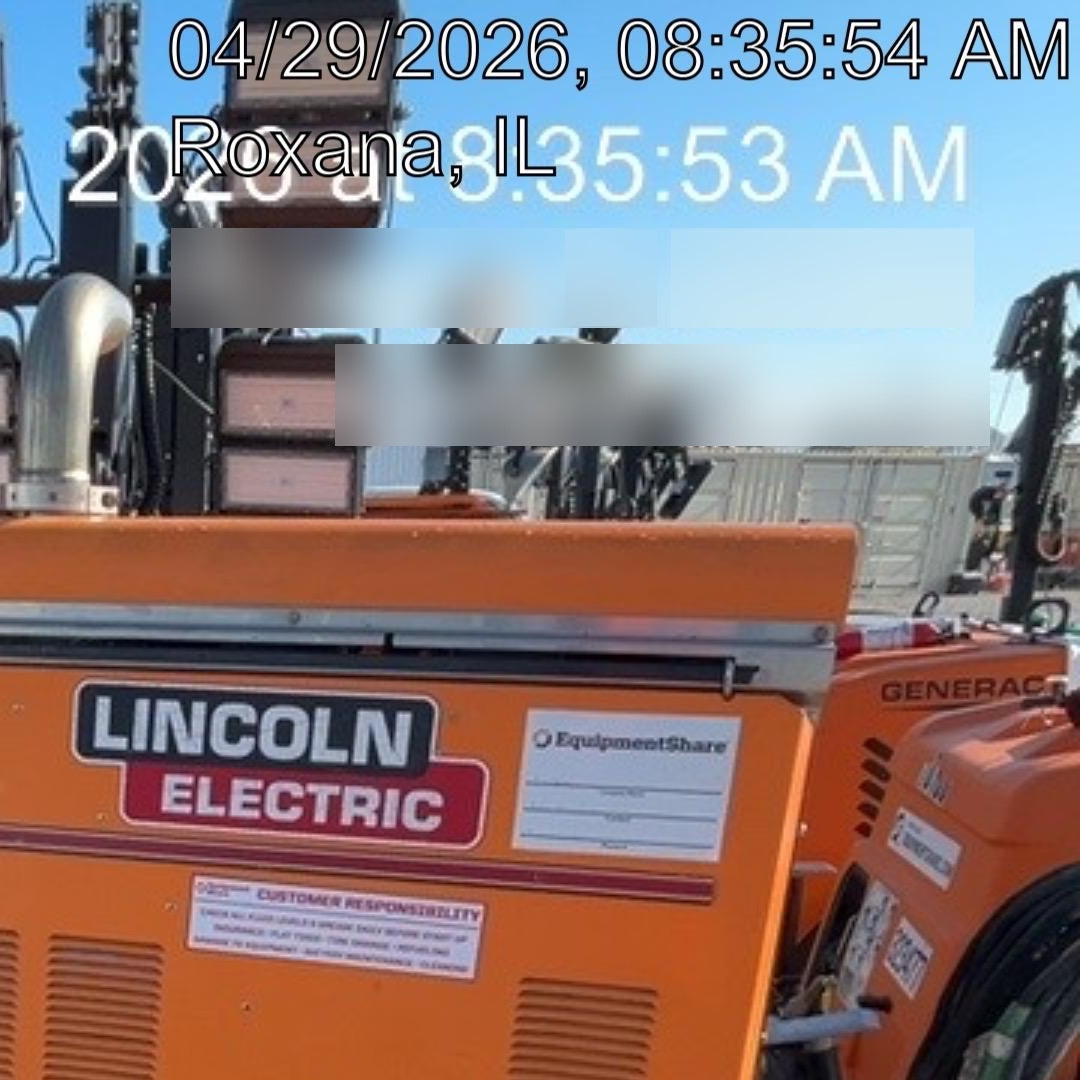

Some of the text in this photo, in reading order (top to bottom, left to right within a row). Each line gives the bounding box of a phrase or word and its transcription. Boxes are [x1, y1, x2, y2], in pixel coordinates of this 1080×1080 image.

[881, 675, 1045, 702] GENERAC
[93, 696, 413, 768] LINCOLN
[555, 731, 727, 754] EquipmentShare
[161, 774, 444, 833] ELECTRIC
[257, 887, 341, 907] CUSTOMER
[344, 896, 480, 921] RESPONSIBILITY
